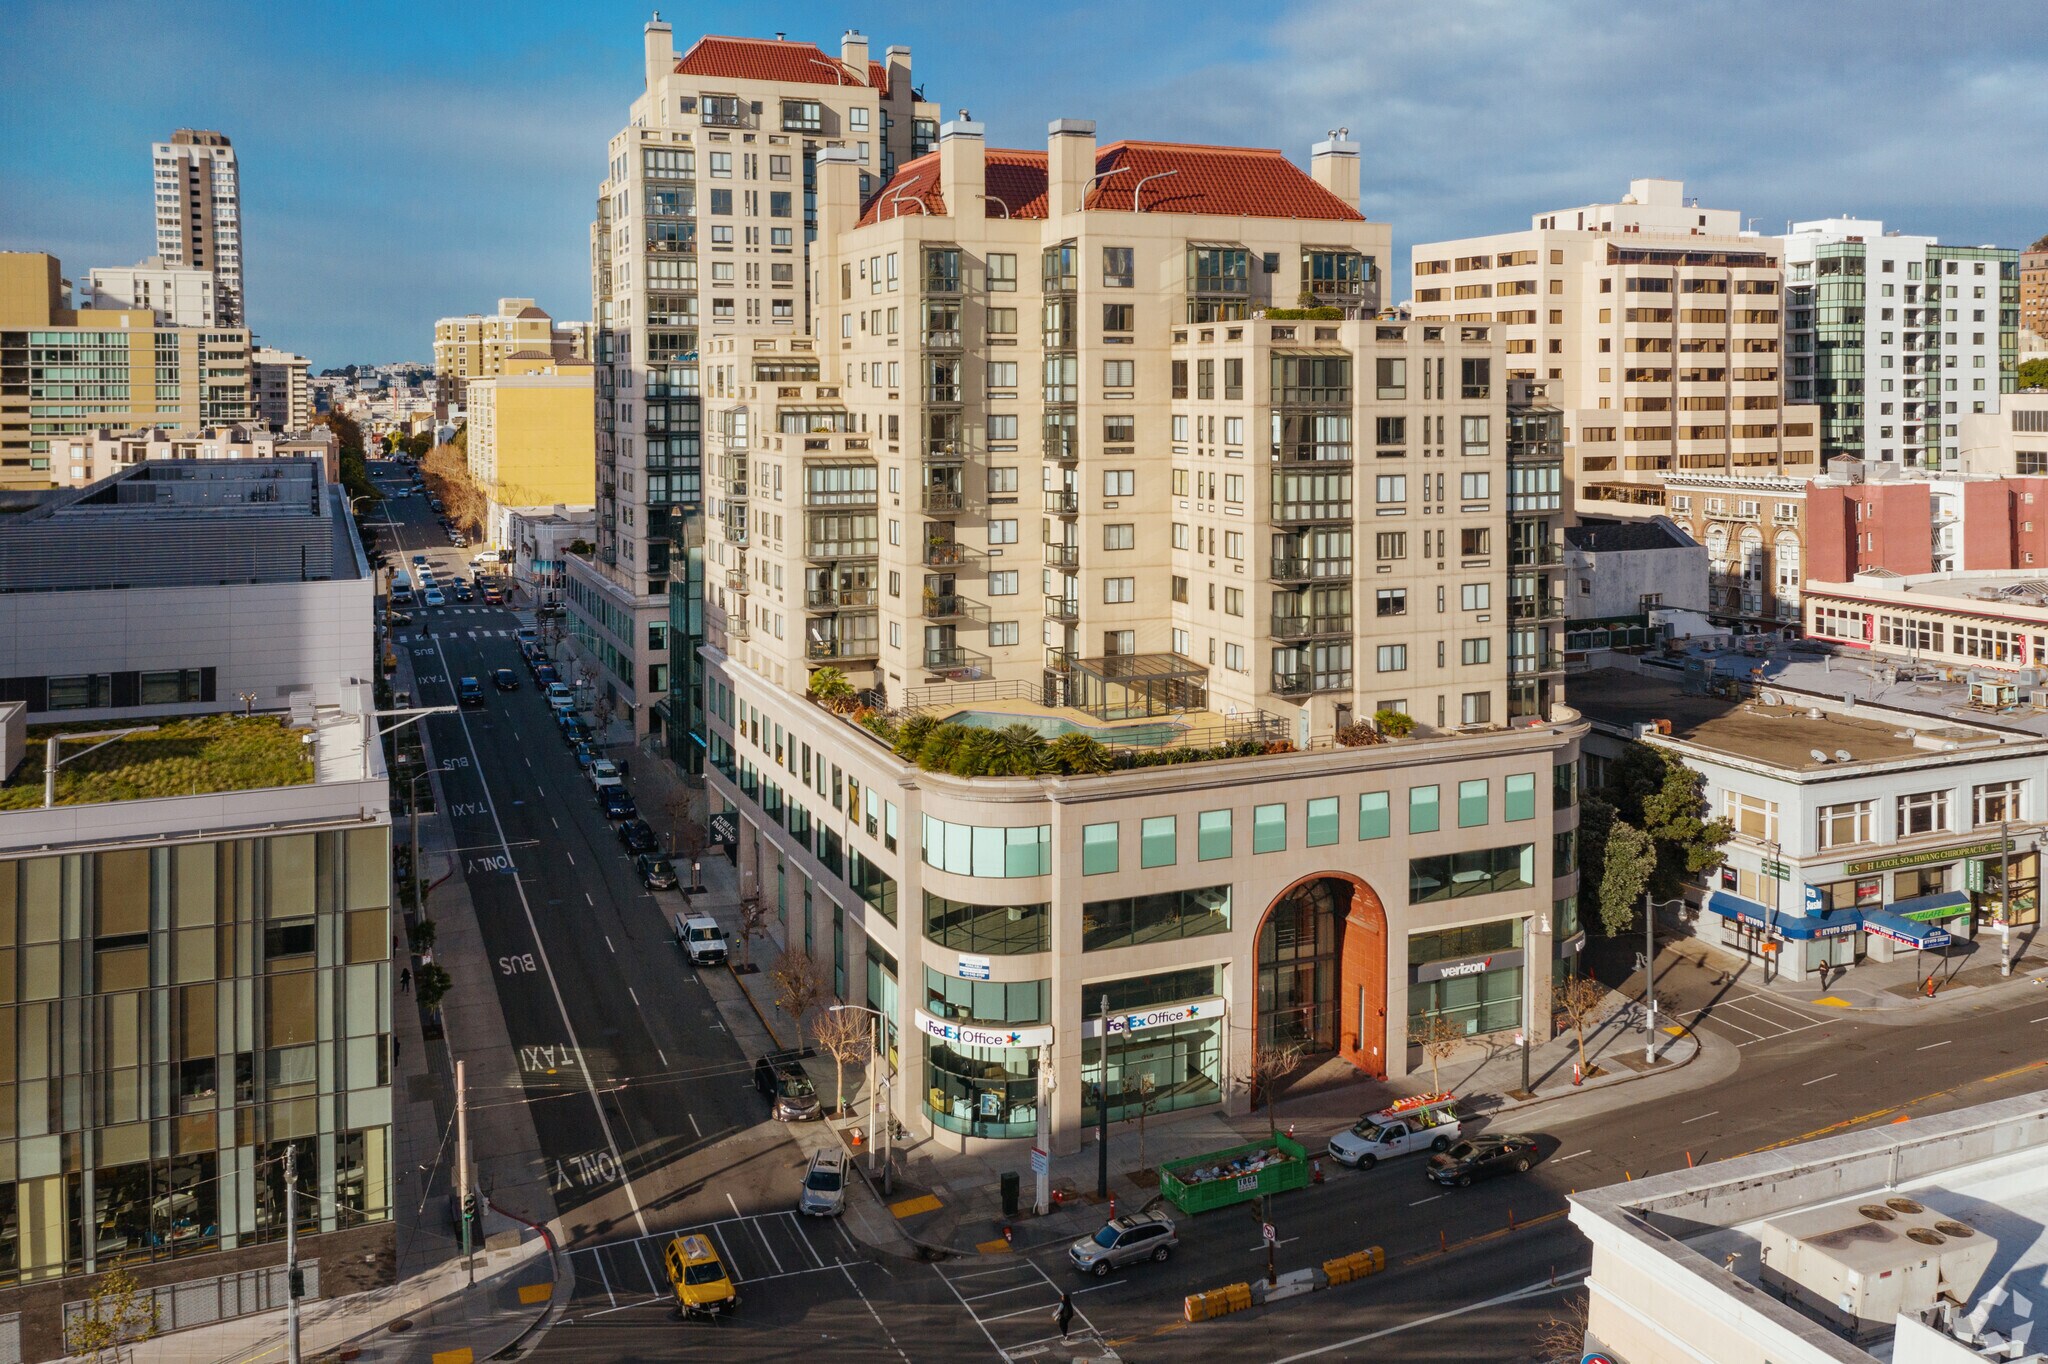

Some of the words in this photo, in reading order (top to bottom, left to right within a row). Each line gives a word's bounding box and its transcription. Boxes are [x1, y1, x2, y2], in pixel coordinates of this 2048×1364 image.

[414, 648, 434, 656] BUS
[418, 675, 446, 685] TAXI
[442, 757, 469, 770] BUS
[451, 802, 488, 816] TAXI
[711, 820, 736, 841] PARKING
[716, 815, 736, 833] PUBLIC
[1914, 851, 1940, 863] HWANG
[1941, 845, 1989, 858] CHIROPRACTIC
[468, 856, 508, 874] ONLY
[499, 953, 536, 975] BUS
[1441, 962, 1485, 977] verizon
[1147, 1011, 1183, 1025] Office
[928, 1020, 960, 1041] FedEx
[962, 1031, 1003, 1045] Office
[520, 1043, 574, 1071] TAXI
[556, 1152, 616, 1190] ONLY
[1238, 1176, 1256, 1186] TOCA
